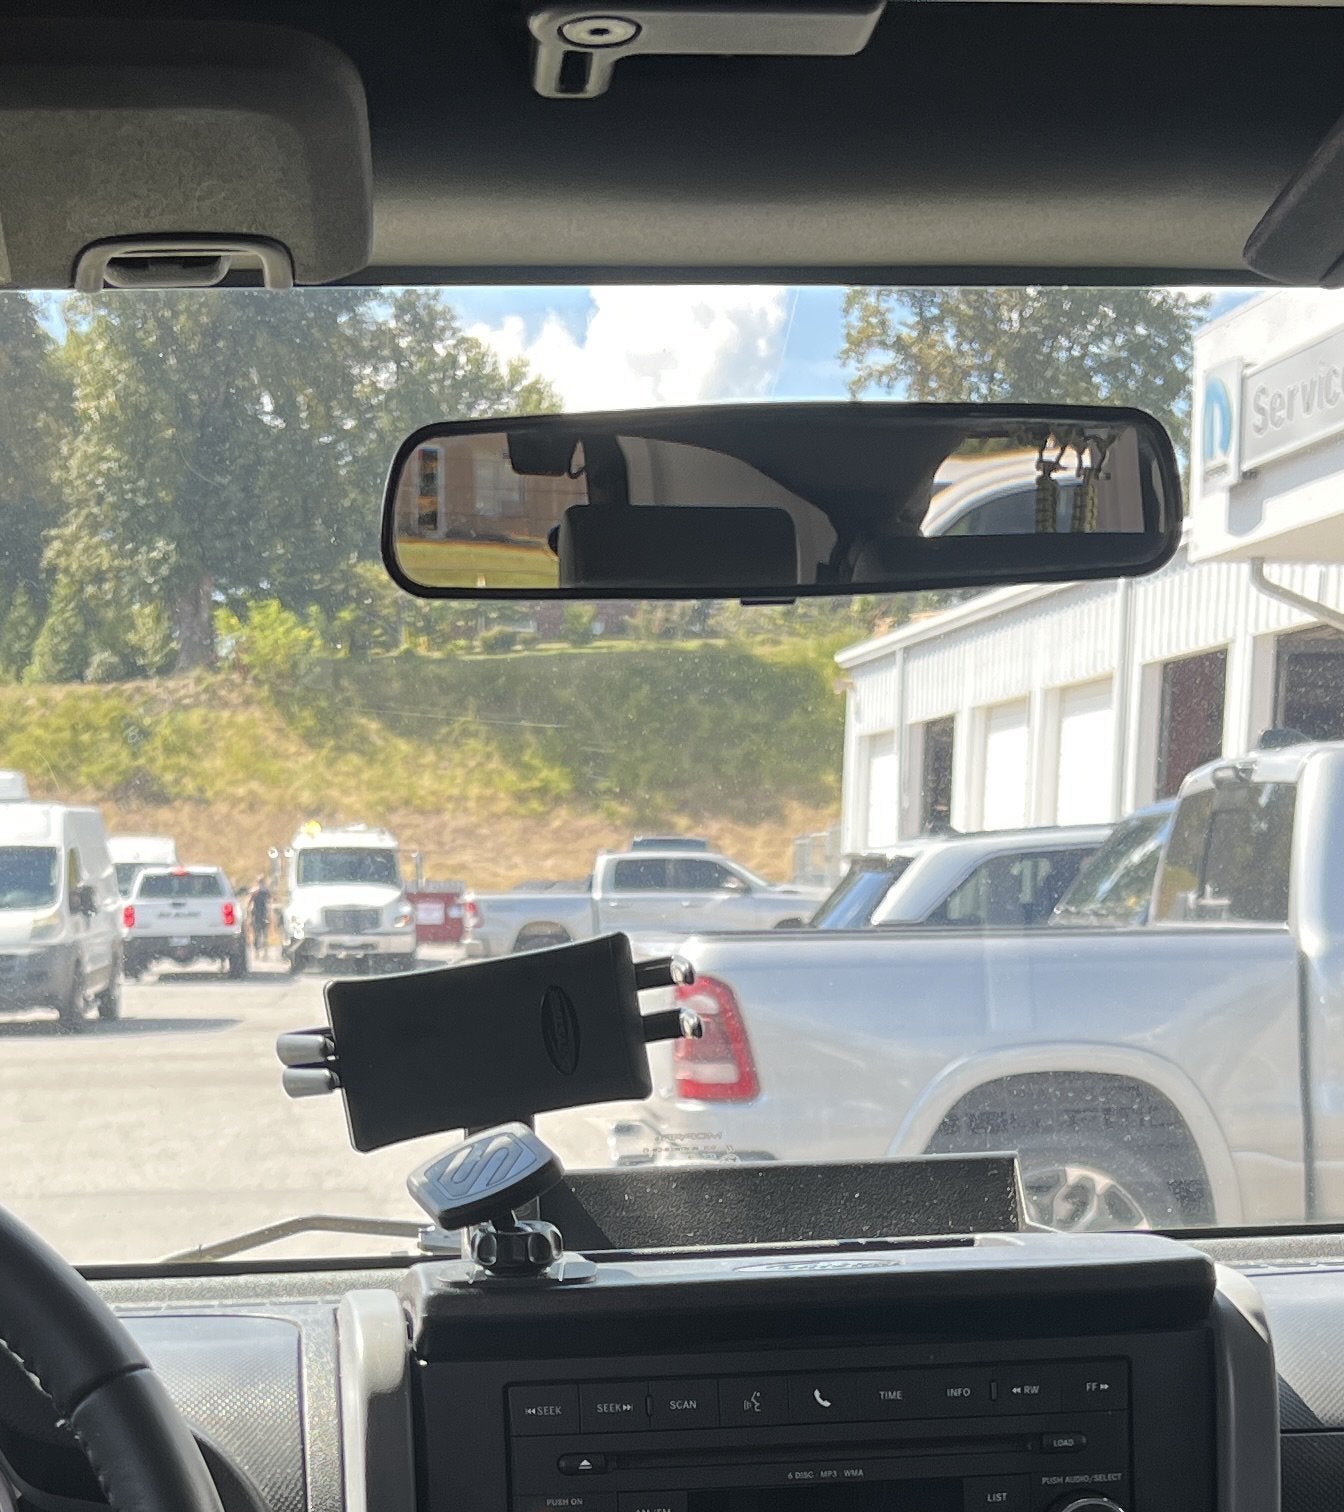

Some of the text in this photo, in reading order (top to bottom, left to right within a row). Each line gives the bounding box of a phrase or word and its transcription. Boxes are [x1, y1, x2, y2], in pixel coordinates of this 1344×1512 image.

[537, 1382, 1097, 1416] SEEK SEEK SCAN TIME INFO RW FF
[1053, 1438, 1074, 1447] LOAD
[820, 1470, 837, 1478] MP3
[843, 1468, 863, 1477] WMA
[987, 1492, 1007, 1502] LIST
